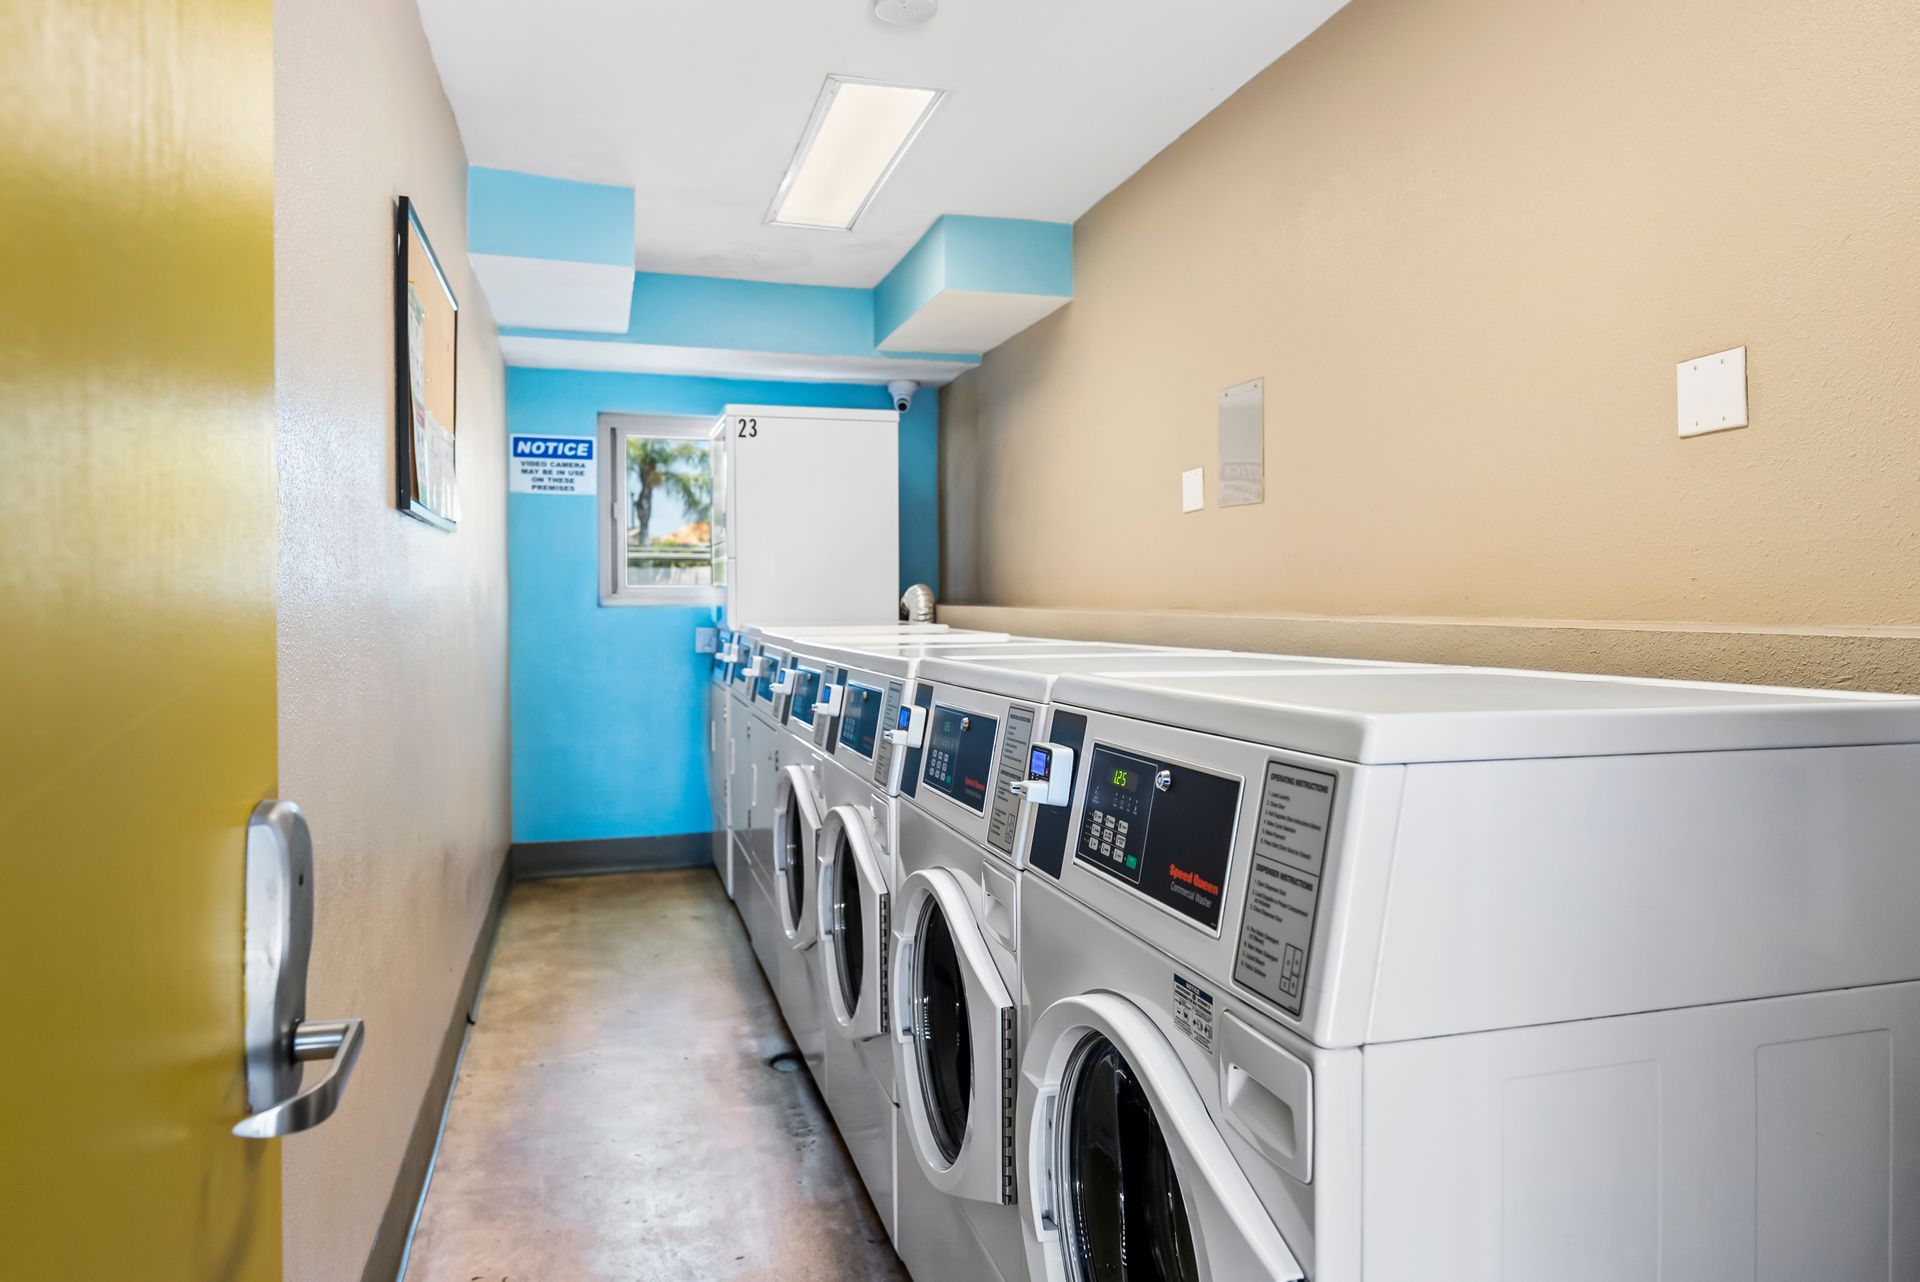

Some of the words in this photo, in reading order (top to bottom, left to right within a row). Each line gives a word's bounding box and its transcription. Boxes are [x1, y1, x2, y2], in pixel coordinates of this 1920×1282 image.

[738, 418, 758, 438] 23
[516, 440, 590, 457] NOTICE
[520, 460, 547, 468] VIDEO
[550, 461, 586, 469] CAMERA
[531, 484, 575, 492] PREMISES
[1169, 863, 1194, 884] Speed
[1193, 873, 1219, 897] Queen
